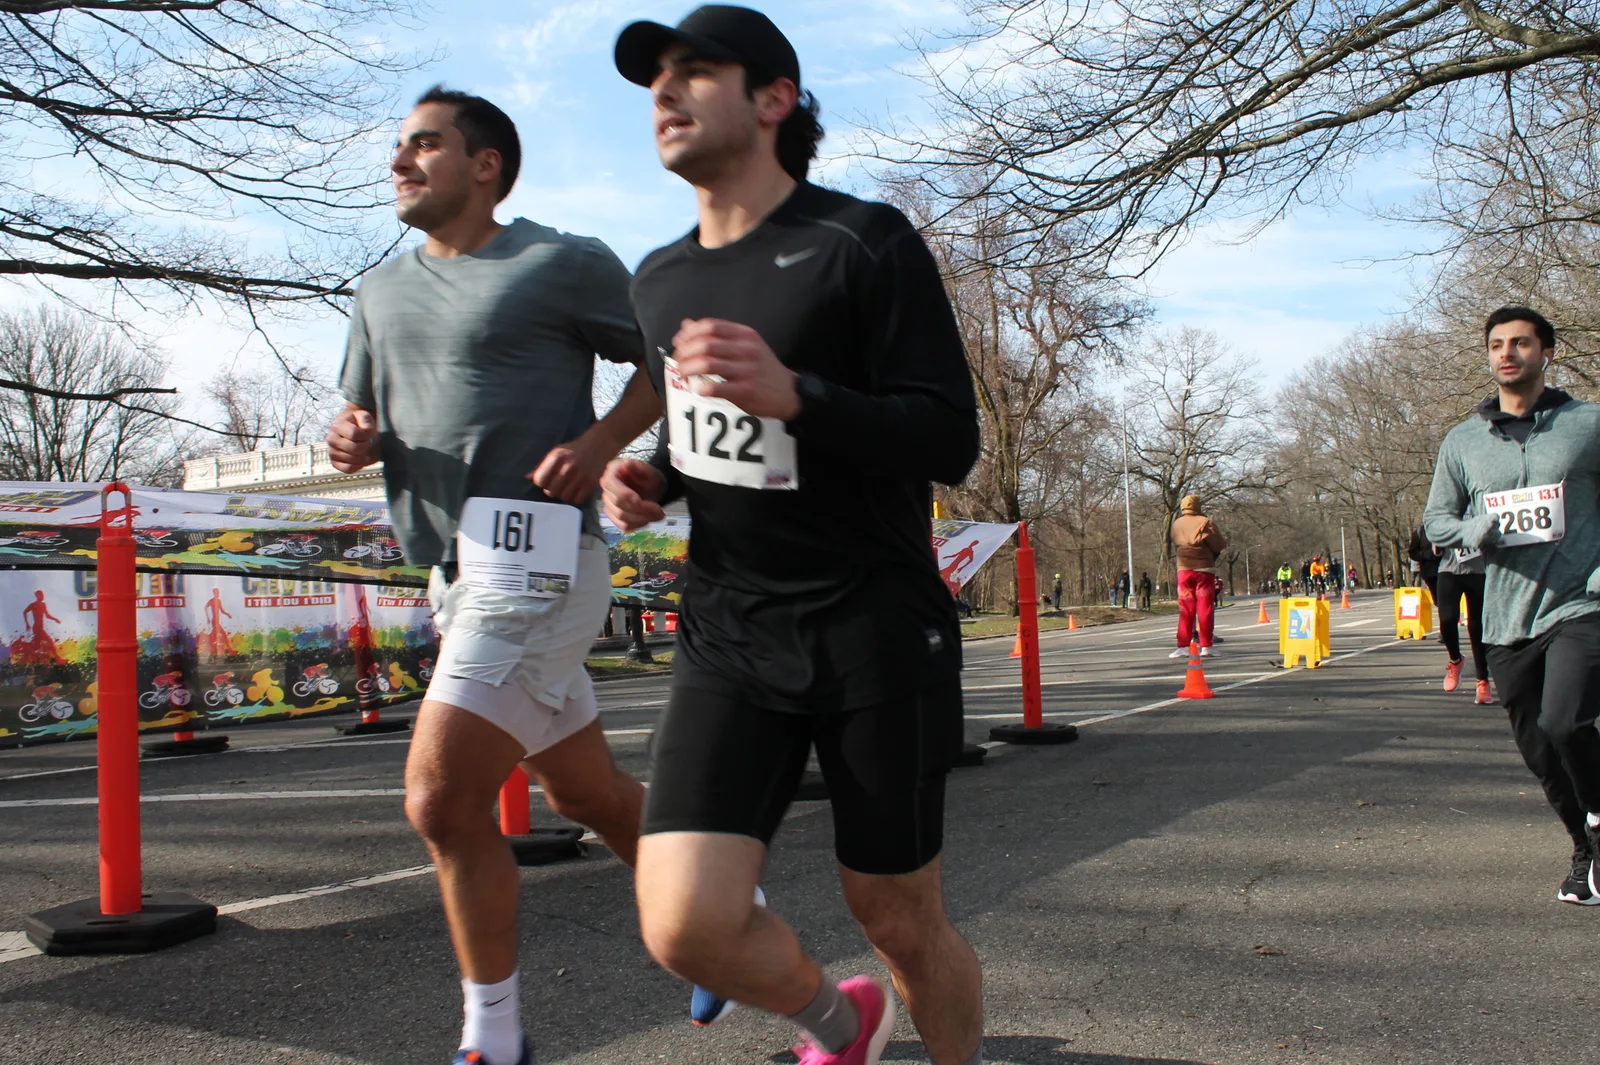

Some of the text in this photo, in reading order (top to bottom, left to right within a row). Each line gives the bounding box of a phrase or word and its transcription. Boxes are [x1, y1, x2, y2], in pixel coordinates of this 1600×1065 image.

[684, 406, 765, 464] 122
[1486, 495, 1506, 508] 13.1
[1537, 487, 1560, 501] 13.1
[1501, 506, 1552, 535] 268
[494, 510, 535, 553] 191
[311, 596, 332, 605] DID
